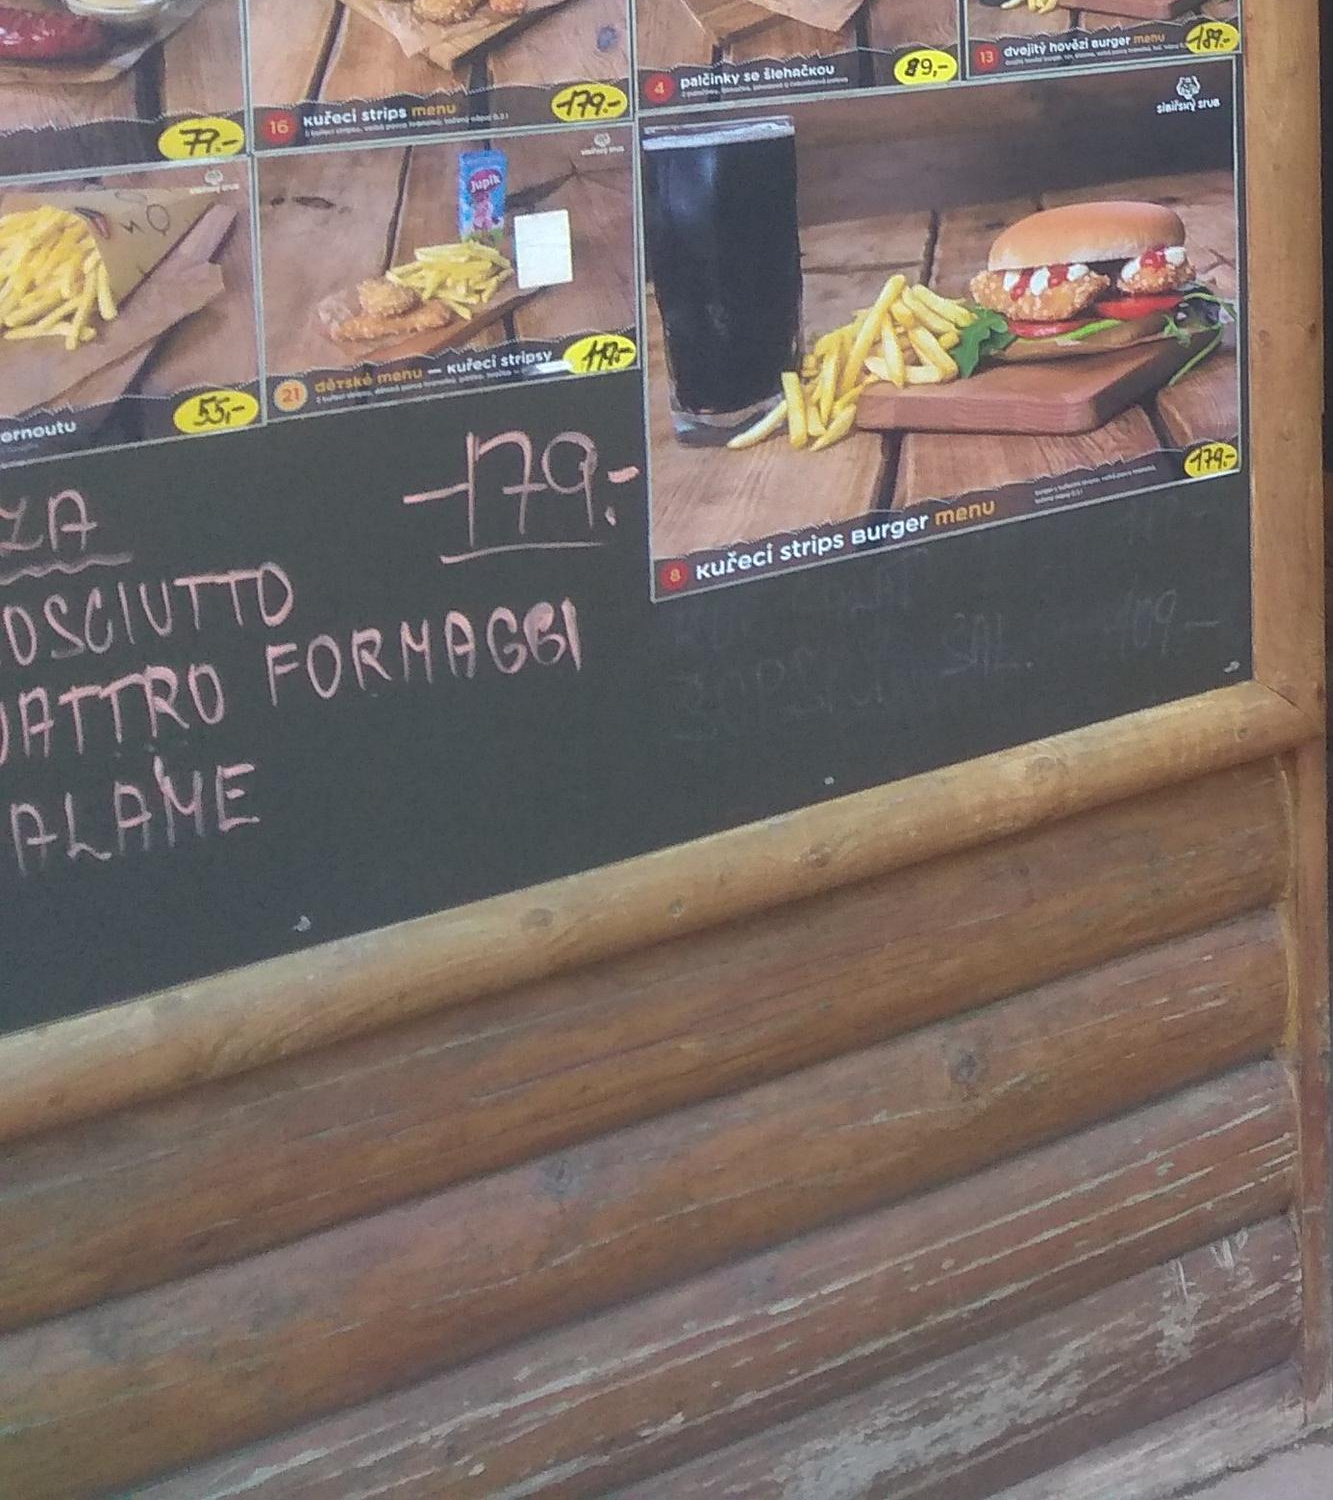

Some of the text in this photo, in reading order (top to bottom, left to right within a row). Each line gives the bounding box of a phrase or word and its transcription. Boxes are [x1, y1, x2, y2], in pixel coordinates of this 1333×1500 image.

[1133, 33, 1165, 45] menu
[360, 106, 408, 125] strips
[411, 102, 457, 118] menu
[376, 367, 424, 385] menu
[780, 533, 845, 563] strips
[934, 500, 996, 527] menu
